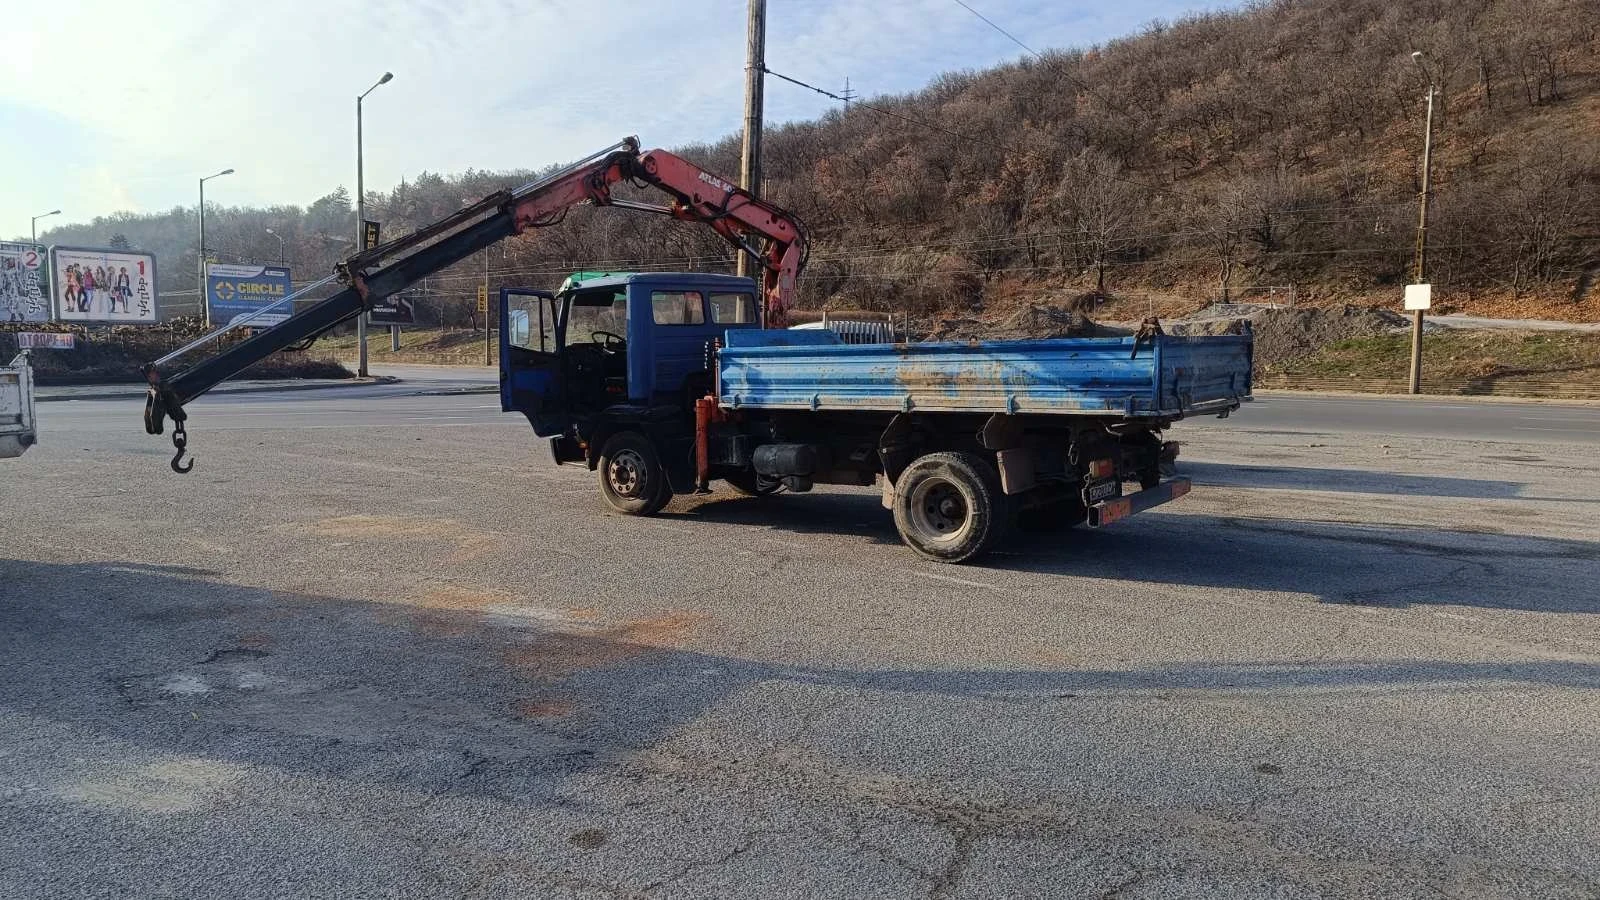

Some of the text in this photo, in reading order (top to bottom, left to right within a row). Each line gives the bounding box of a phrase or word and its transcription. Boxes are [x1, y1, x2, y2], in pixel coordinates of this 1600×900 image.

[698, 171, 721, 188] ATLAS
[26, 251, 38, 267] 2
[137, 260, 145, 275] 1
[236, 282, 285, 296] CIRCLE
